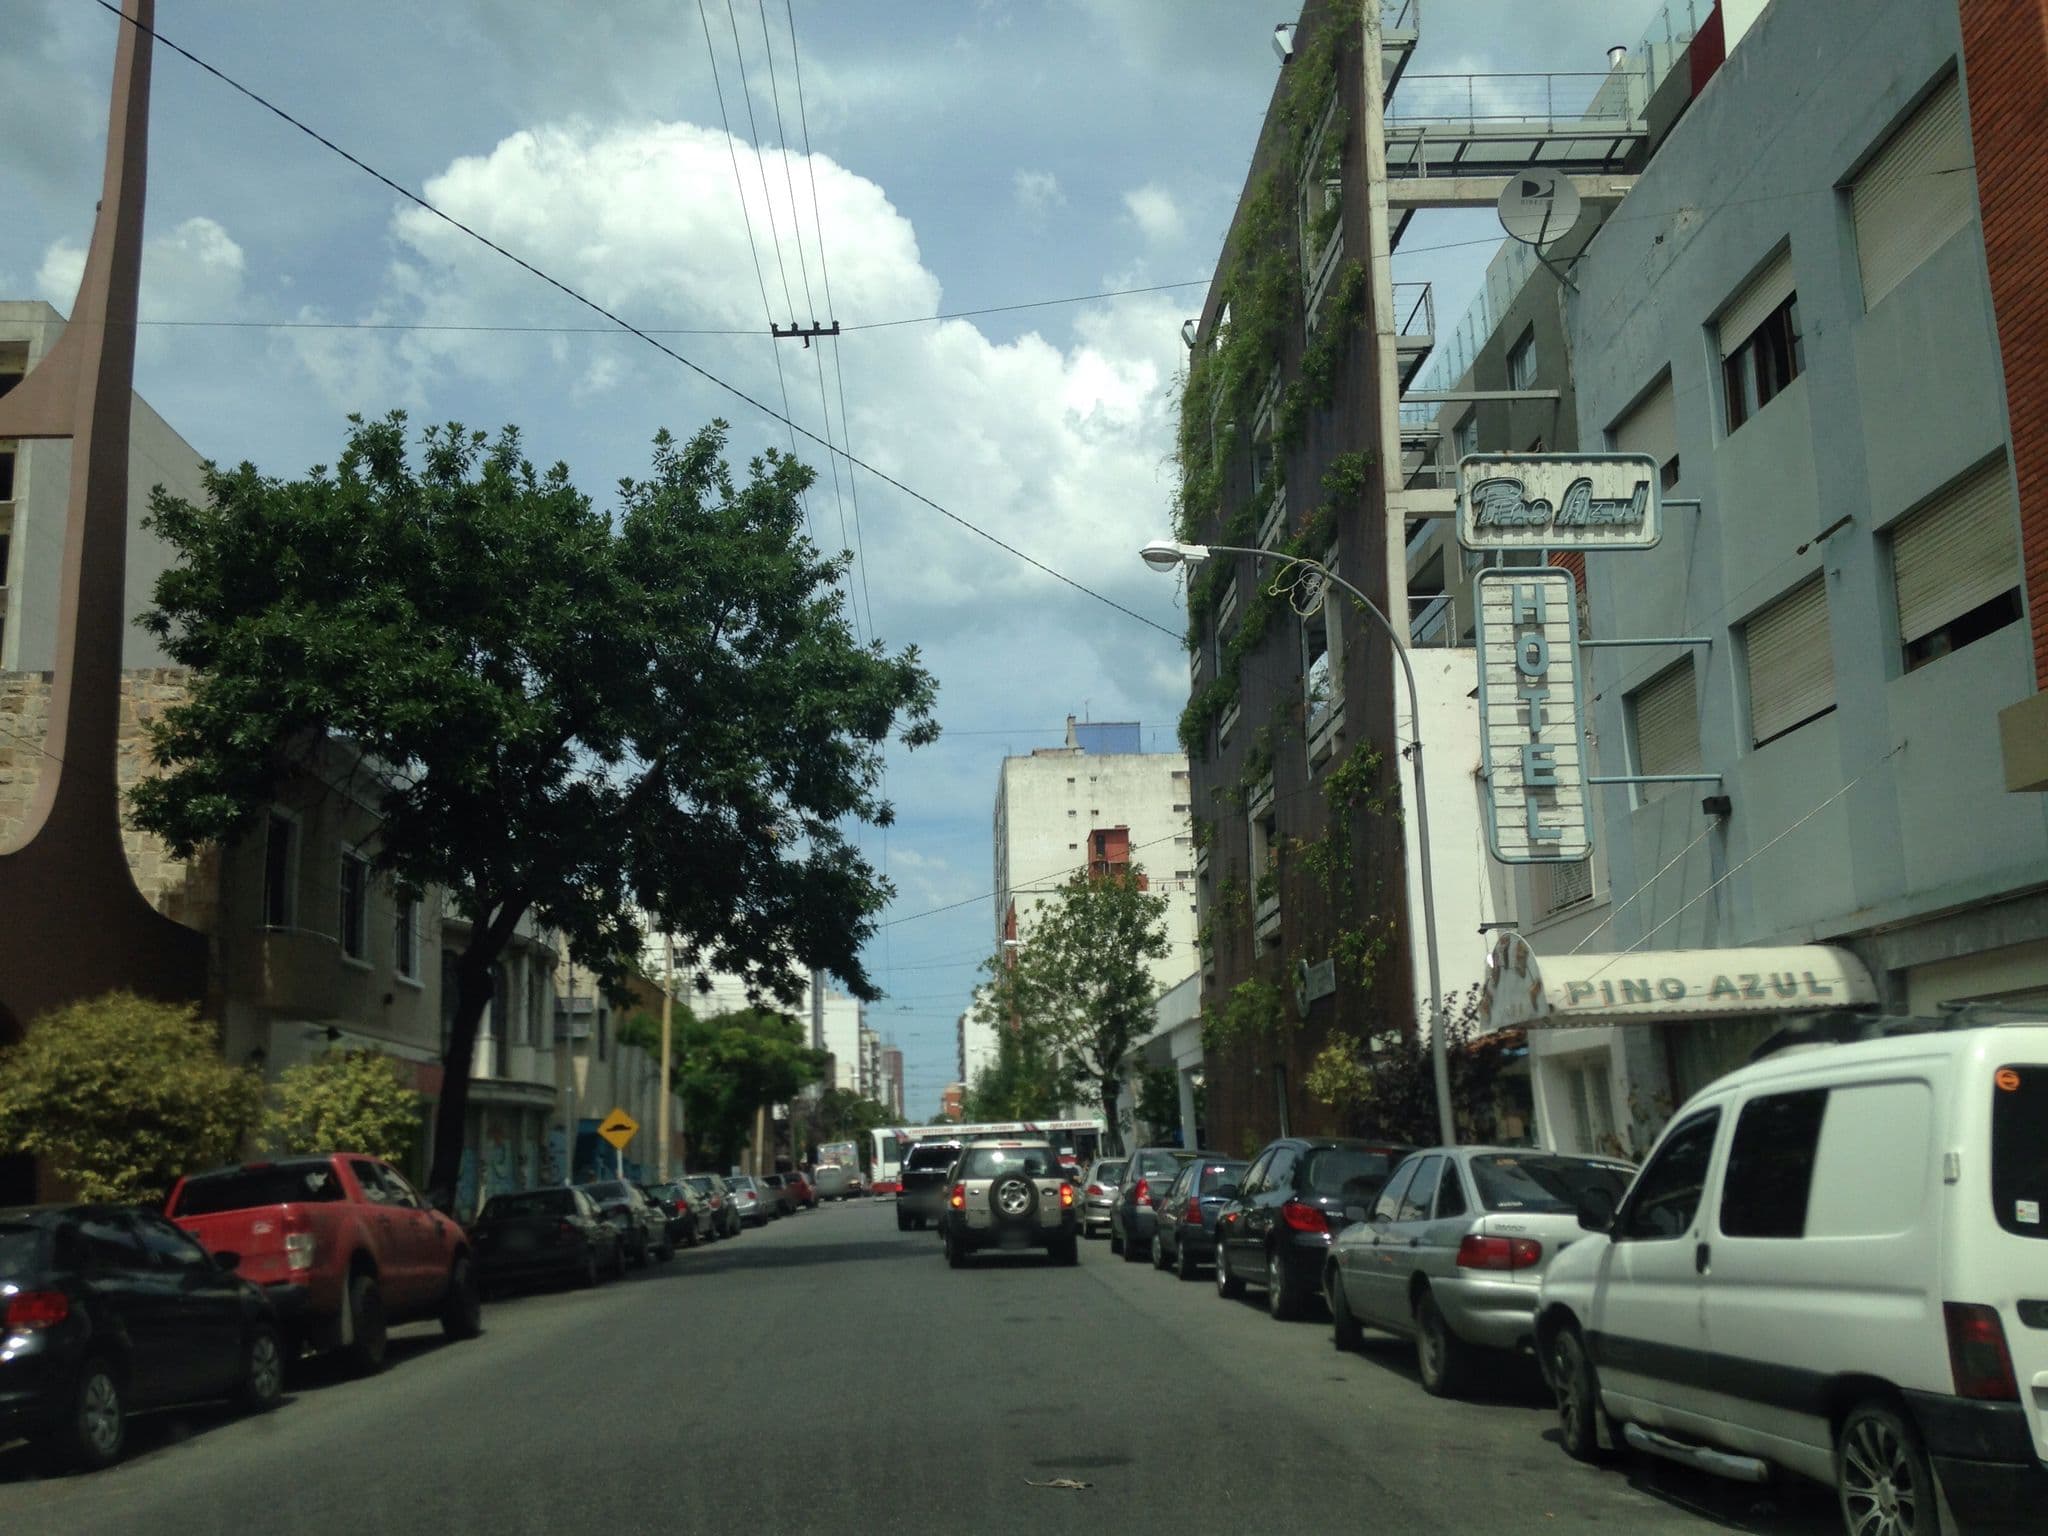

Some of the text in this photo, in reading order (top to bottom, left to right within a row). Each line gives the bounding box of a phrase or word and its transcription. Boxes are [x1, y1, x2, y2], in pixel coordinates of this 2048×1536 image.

[1553, 477, 1650, 527] Azul
[1513, 583, 1562, 839] HOTEL
[1564, 971, 1833, 1007] PINO AZUL
